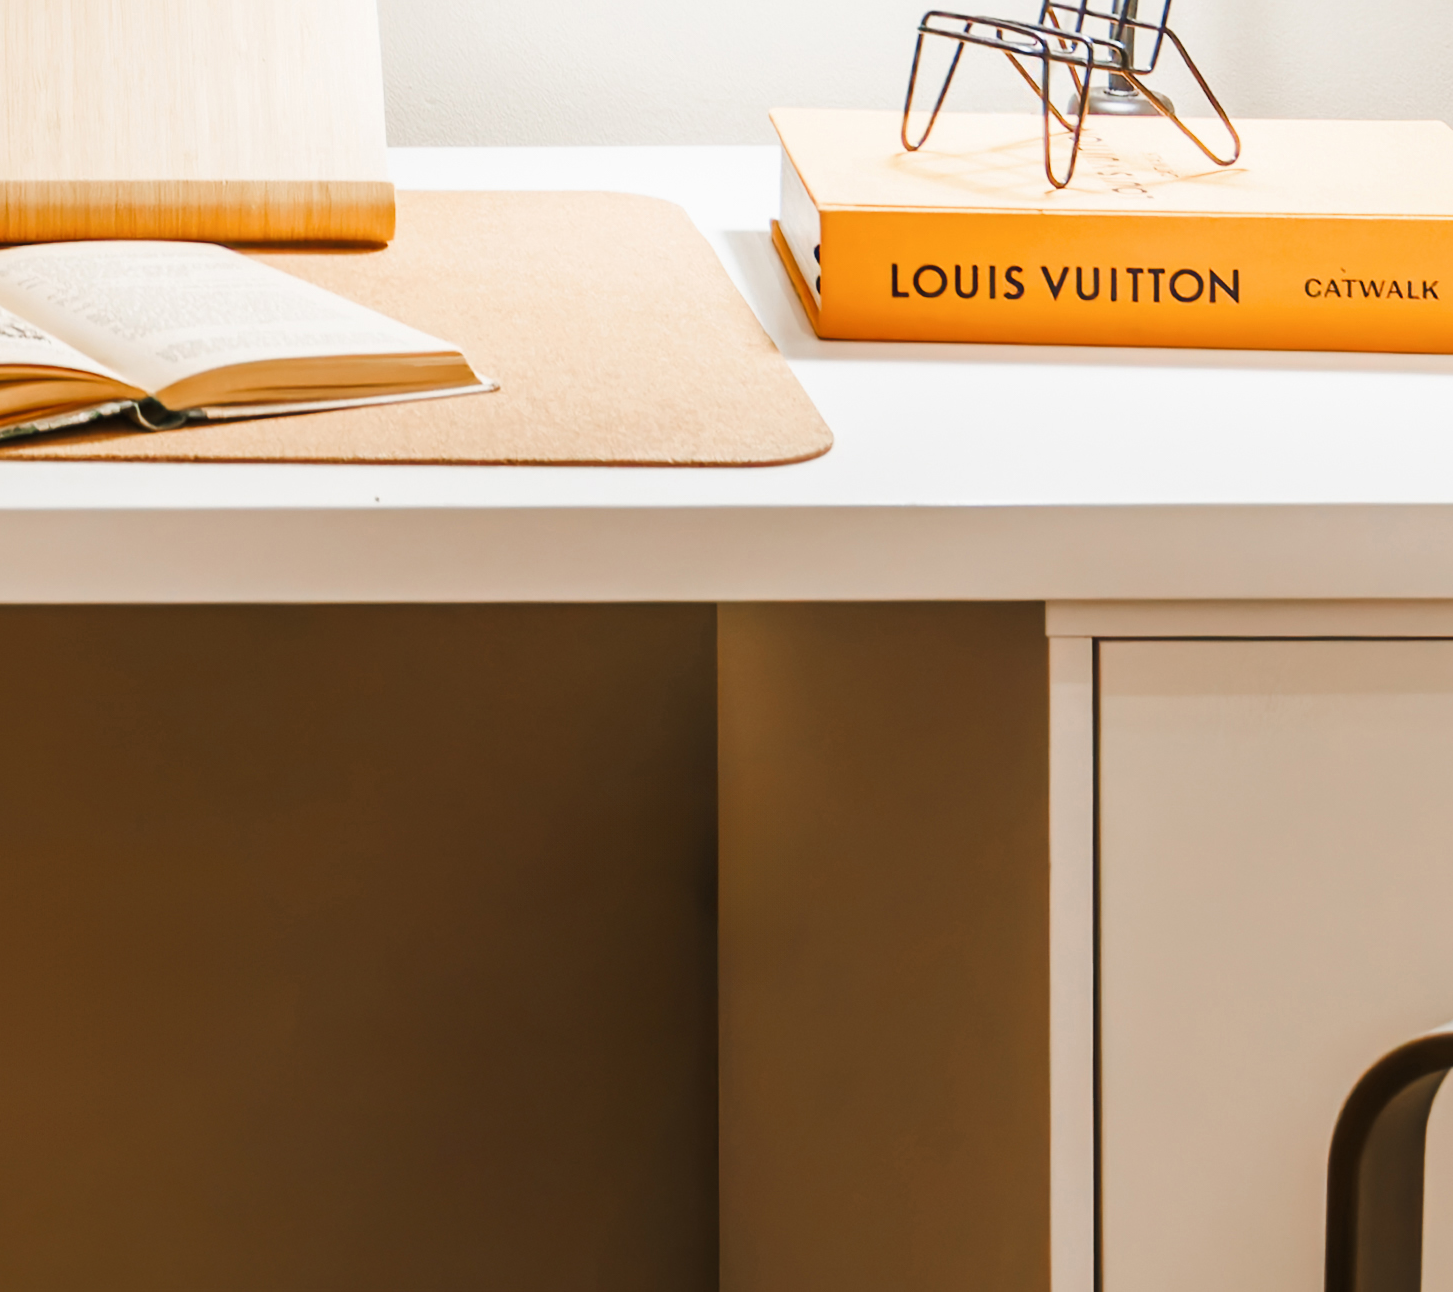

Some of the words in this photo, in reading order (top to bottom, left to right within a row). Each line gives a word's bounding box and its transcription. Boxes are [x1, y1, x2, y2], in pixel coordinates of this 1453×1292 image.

[889, 263, 1025, 301] LOUIS
[1040, 265, 1241, 305] VUITTON
[1304, 277, 1440, 301] CATWALK
